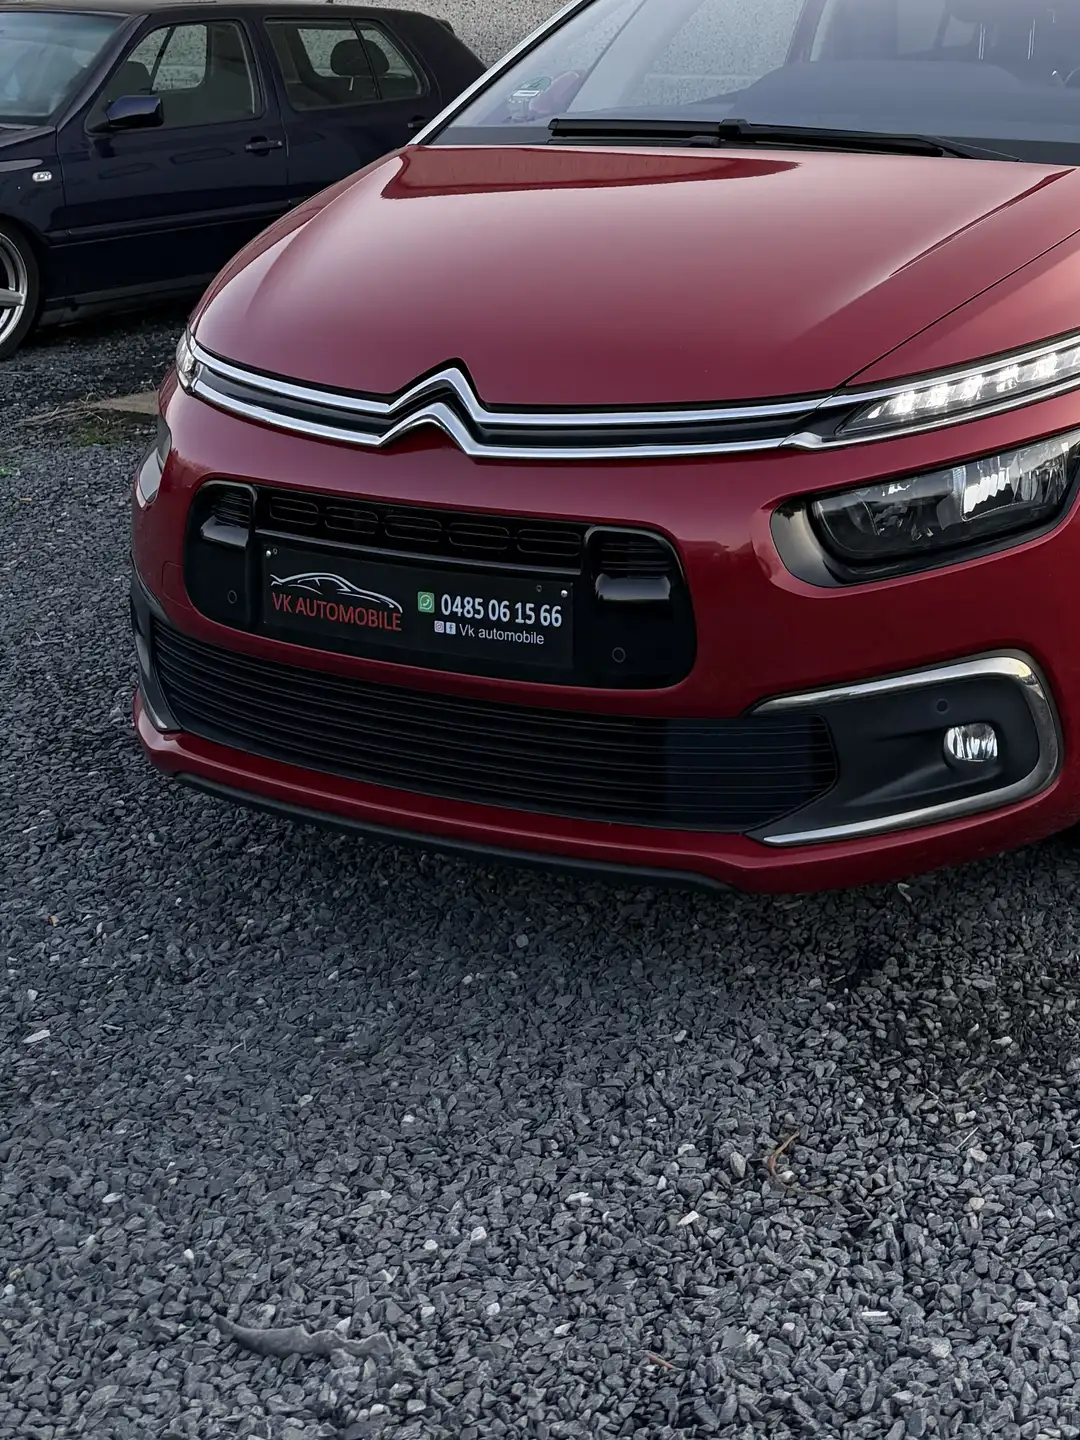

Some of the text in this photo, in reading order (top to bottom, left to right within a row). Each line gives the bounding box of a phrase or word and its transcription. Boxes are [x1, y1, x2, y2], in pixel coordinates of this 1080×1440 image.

[272, 592, 402, 631] VK AUTOMOBILE
[441, 593, 562, 627] 0485 06 15 66
[459, 623, 545, 645] Vk automobile
